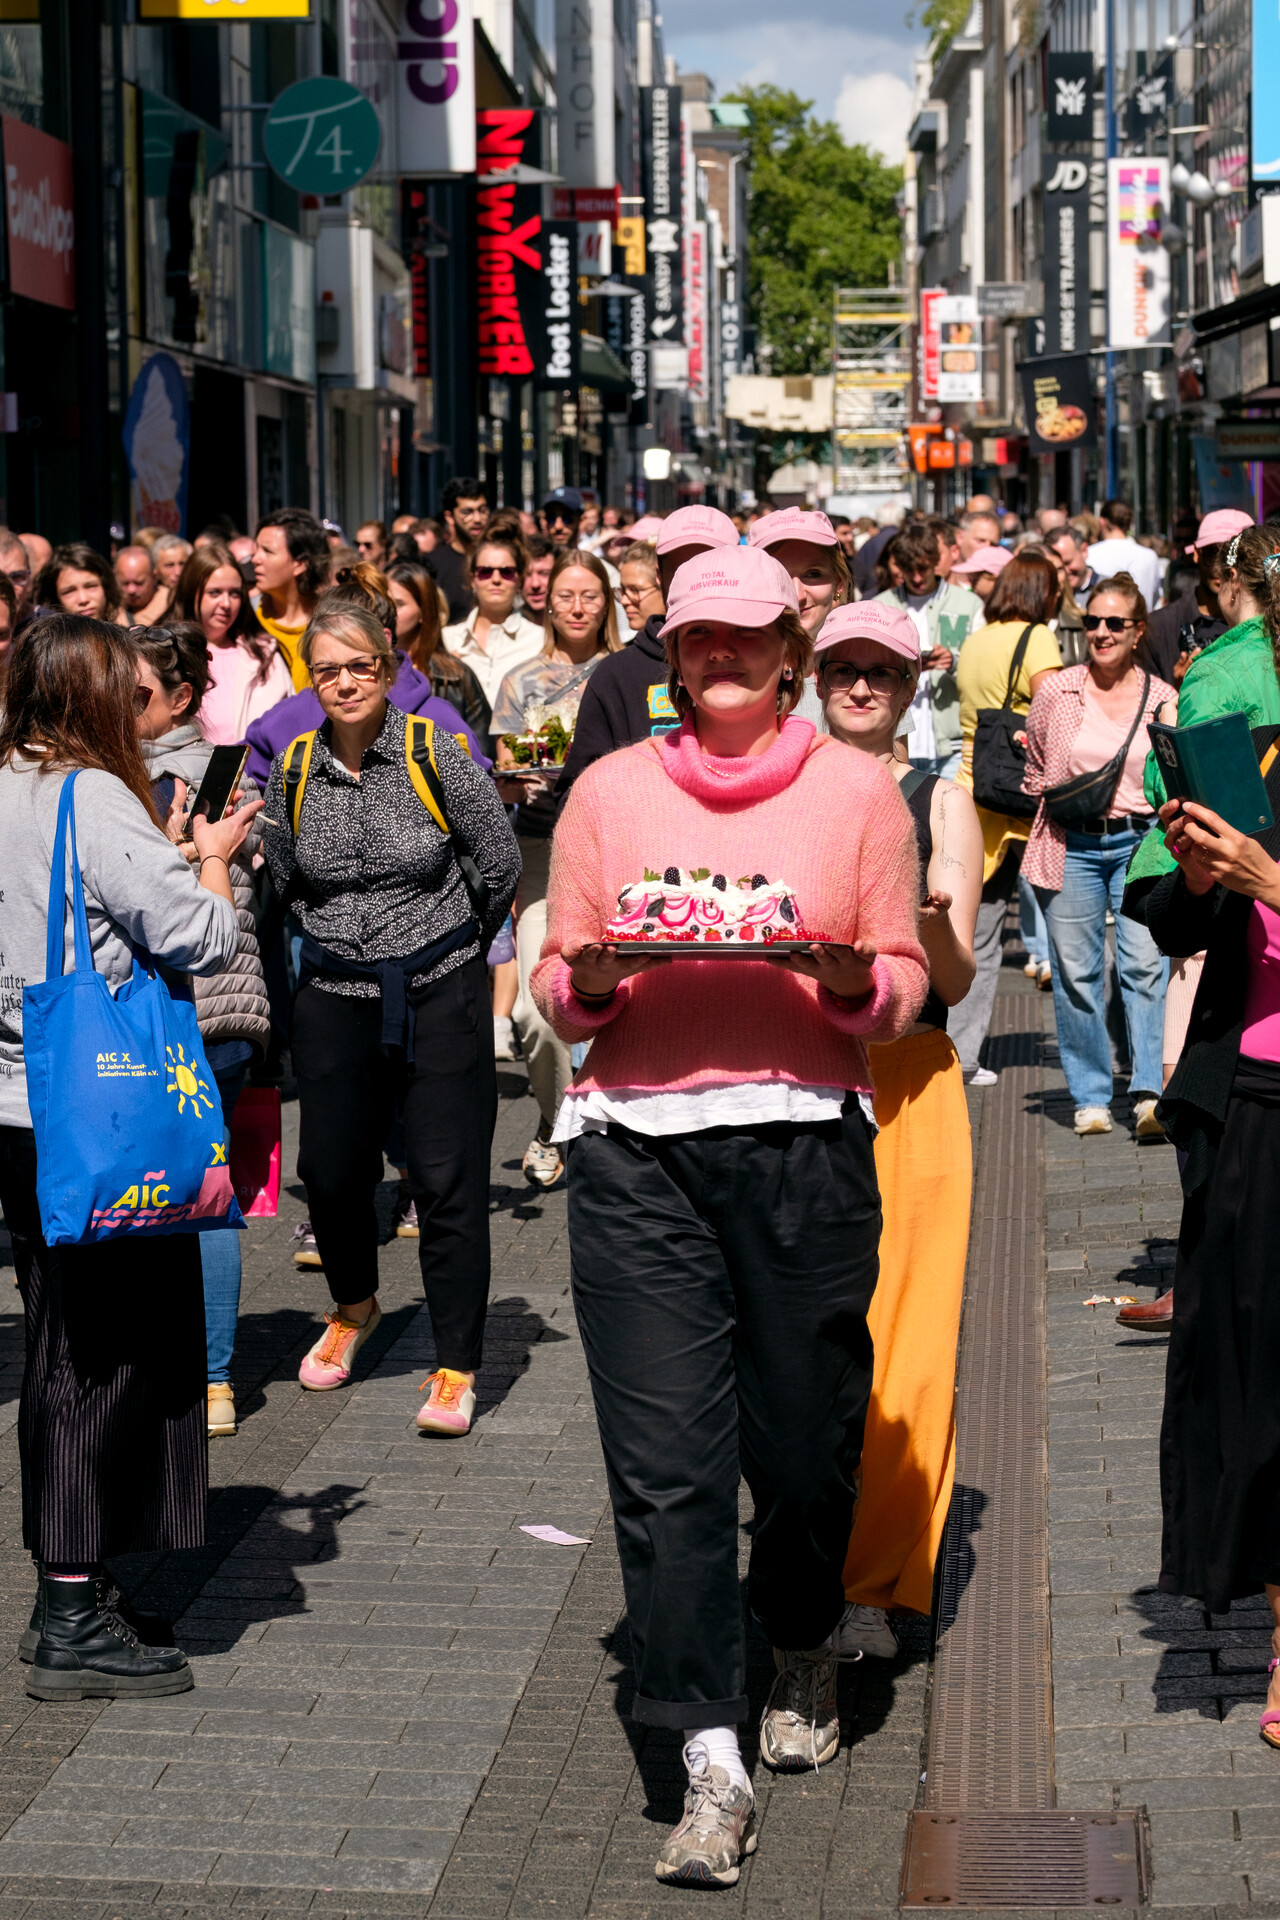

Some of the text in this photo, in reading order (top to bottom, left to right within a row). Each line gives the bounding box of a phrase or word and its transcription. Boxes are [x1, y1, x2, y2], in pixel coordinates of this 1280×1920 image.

[1046, 160, 1088, 194] JD
[652, 87, 672, 312] SANDY LEDERATELIER
[476, 109, 542, 376] NEW YORKER
[1059, 206, 1075, 290] TRAINERS
[546, 233, 571, 379] Foot Locker
[1059, 310, 1075, 351] KING
[630, 294, 646, 400] VERO MODA
[688, 579, 741, 592] AUSVERKAUF
[700, 571, 726, 580] TOTAL
[846, 615, 891, 627] AUSVERKAUF
[859, 610, 882, 618] TOTAL
[96, 1052, 131, 1063] AIC X
[131, 1069, 147, 1077] Köln
[210, 1142, 227, 1166] X
[111, 1183, 171, 1209] AIC
